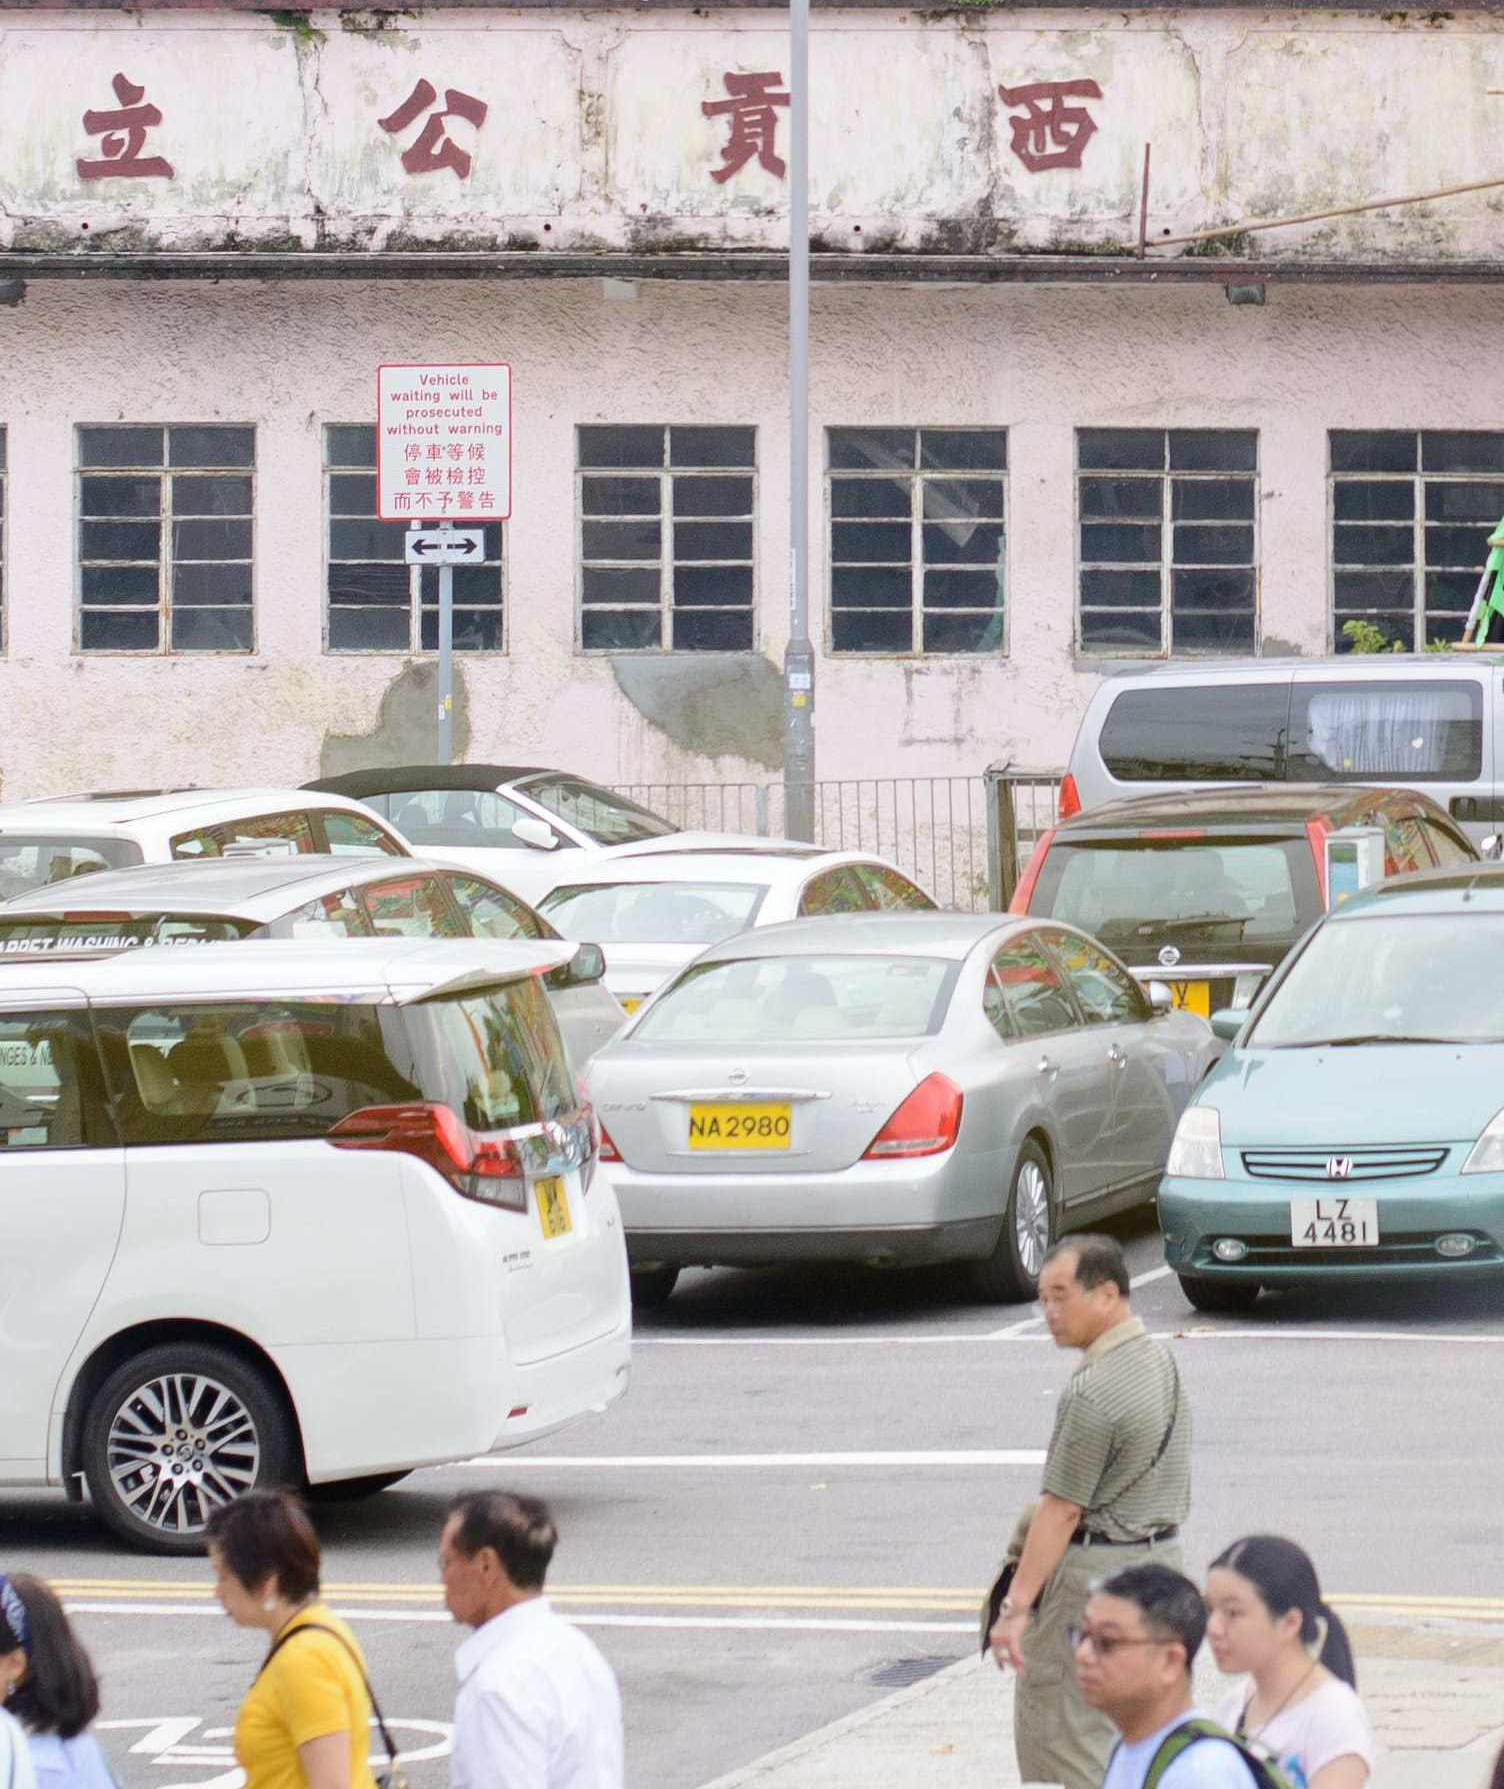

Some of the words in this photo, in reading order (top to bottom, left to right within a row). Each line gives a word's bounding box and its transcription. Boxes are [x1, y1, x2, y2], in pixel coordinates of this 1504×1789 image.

[419, 373, 470, 386] Vehicle
[390, 390, 441, 404] waiting
[448, 389, 473, 401] will
[481, 388, 497, 401] be
[405, 405, 483, 420] prosecuted
[386, 423, 440, 436] without
[448, 422, 503, 437] warning
[404, 443, 486, 462] 停車等候
[404, 466, 486, 486] 會被檢控
[393, 490, 496, 511] 而不予警告
[1315, 1199, 1352, 1221] LZ
[1303, 1221, 1368, 1244] 4481
